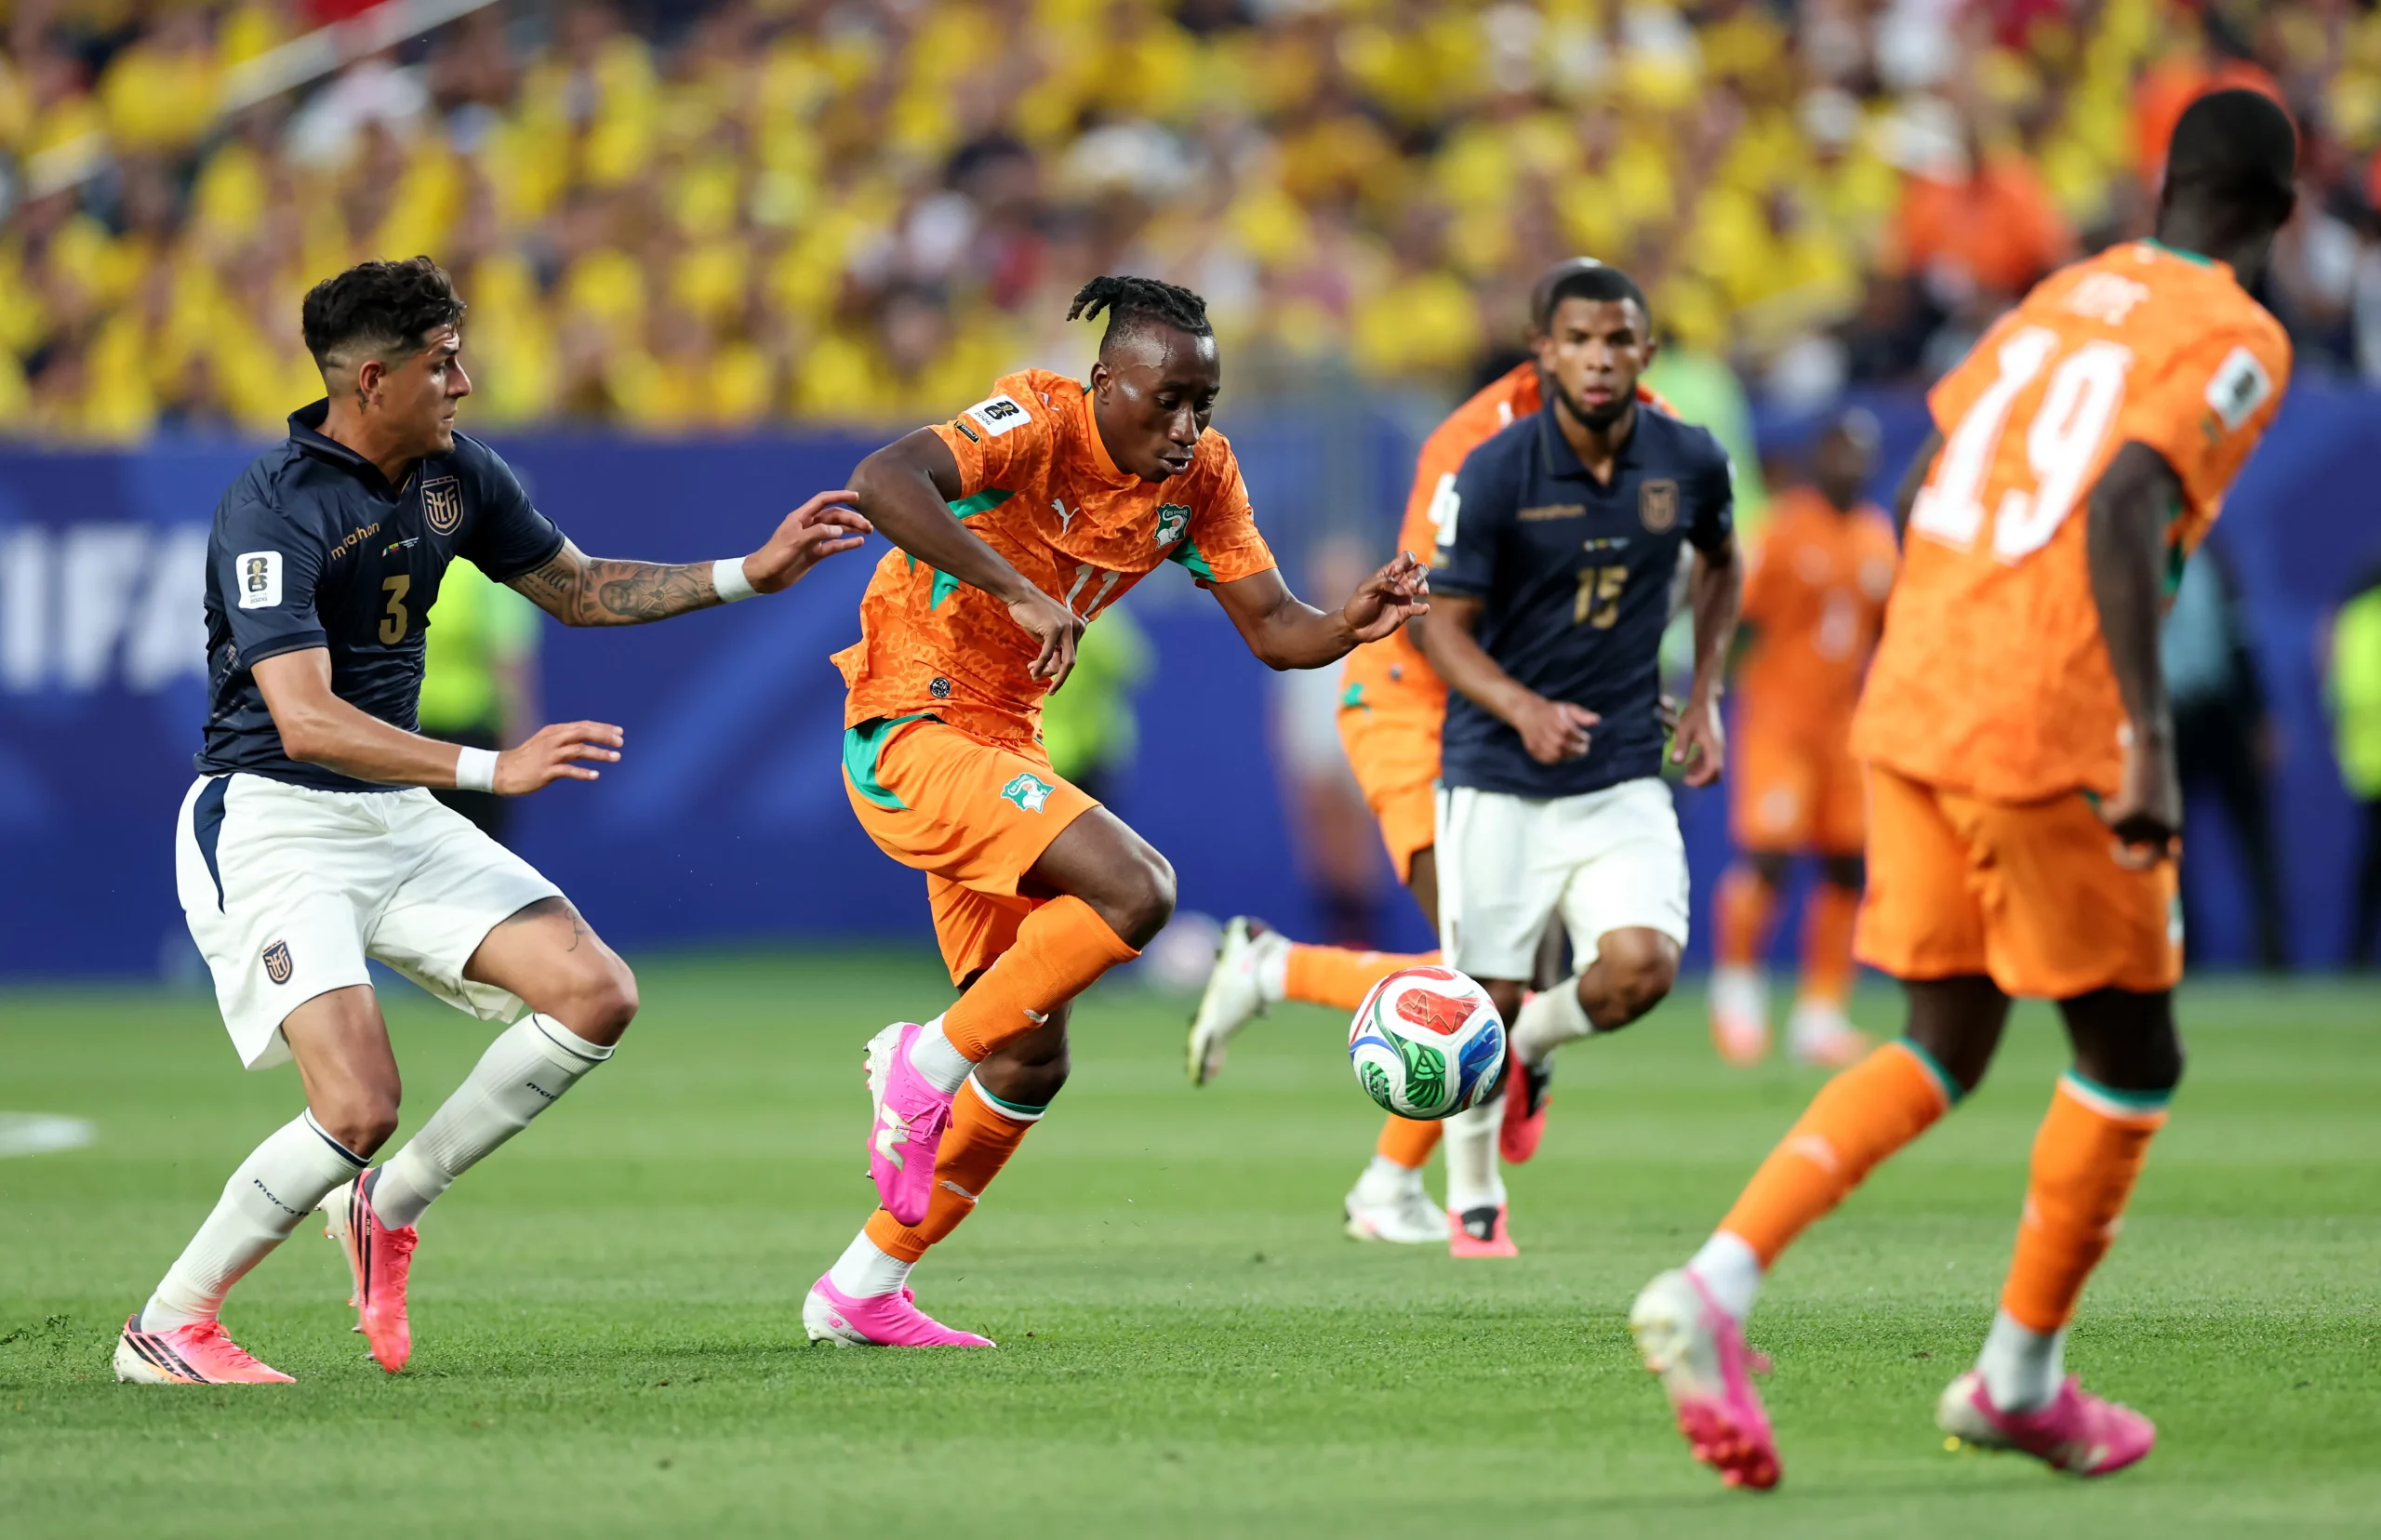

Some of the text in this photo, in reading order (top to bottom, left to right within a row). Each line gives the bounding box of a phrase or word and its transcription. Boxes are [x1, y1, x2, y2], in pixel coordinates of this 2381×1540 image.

[1909, 324, 2135, 565] 19
[379, 574, 410, 644] 3
[1066, 564, 1122, 624] 11
[1573, 565, 1629, 630] 15
